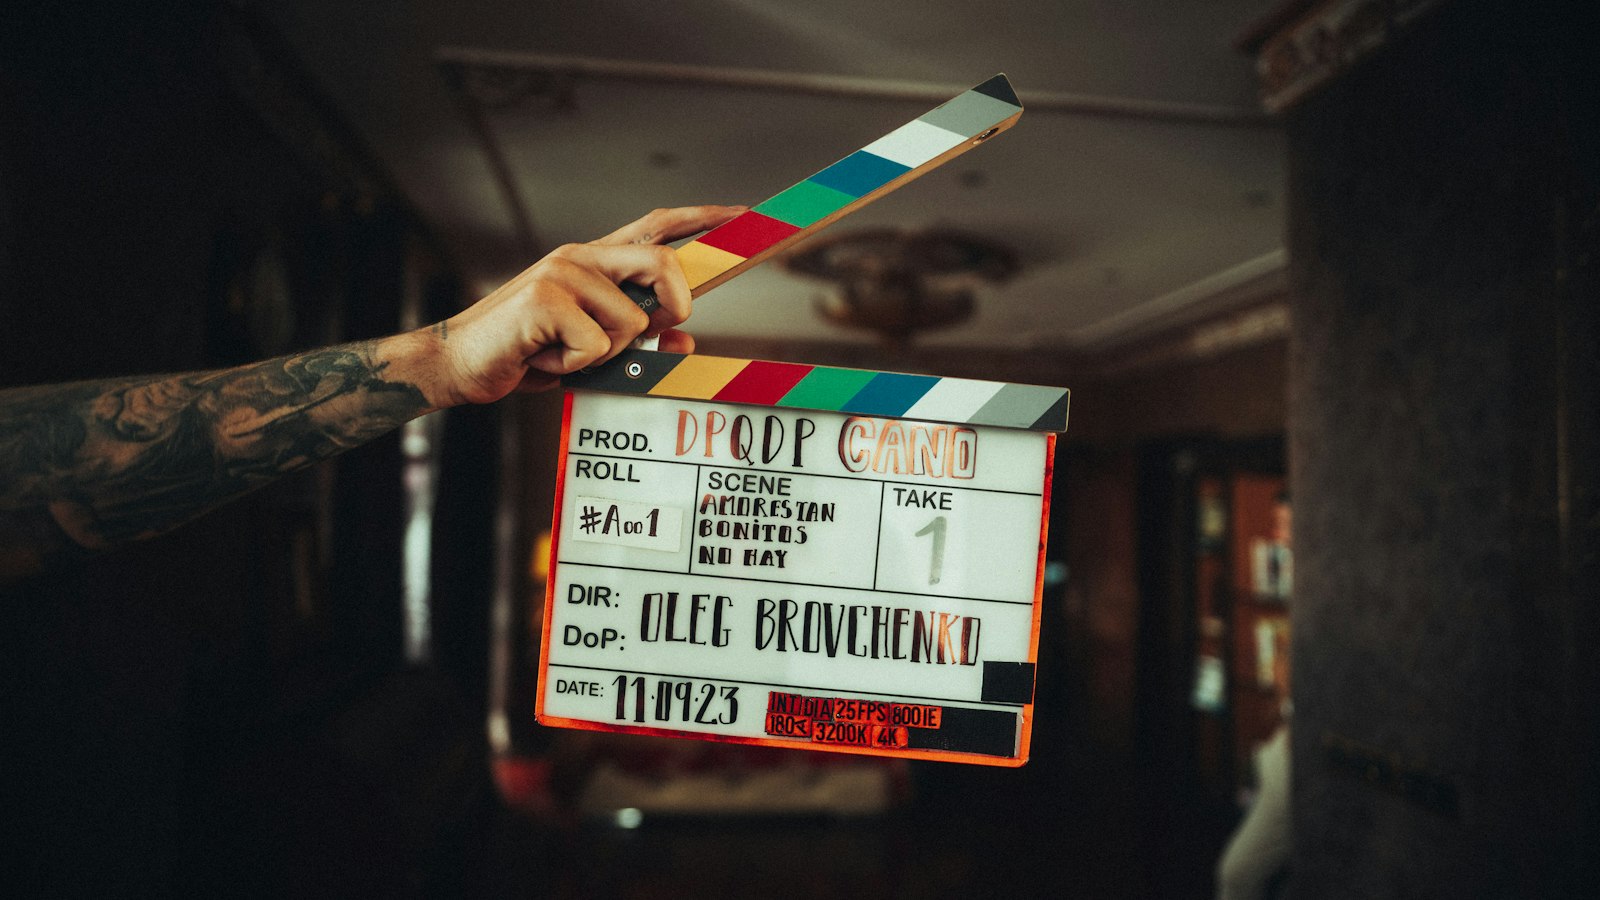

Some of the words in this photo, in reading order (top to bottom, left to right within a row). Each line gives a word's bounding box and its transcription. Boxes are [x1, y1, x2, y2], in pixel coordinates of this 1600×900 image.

[578, 428, 653, 453] PROD.
[675, 409, 815, 467] DPQDP
[838, 416, 977, 479] CANO
[575, 459, 641, 483] ROLL
[708, 471, 792, 496] SCENE
[893, 487, 953, 511] TAKE
[698, 545, 732, 565] NO
[743, 549, 788, 568] HAY
[914, 515, 947, 586] 1
[567, 583, 620, 608] DIR:
[563, 624, 626, 651] DoP:
[640, 592, 734, 648] OLEG
[755, 598, 981, 666] BROVCHENKO
[556, 679, 604, 698] DATE:
[771, 691, 797, 715] INT
[804, 699, 831, 720] DIA
[816, 722, 867, 745] 3200K
[877, 727, 898, 746] 4K
